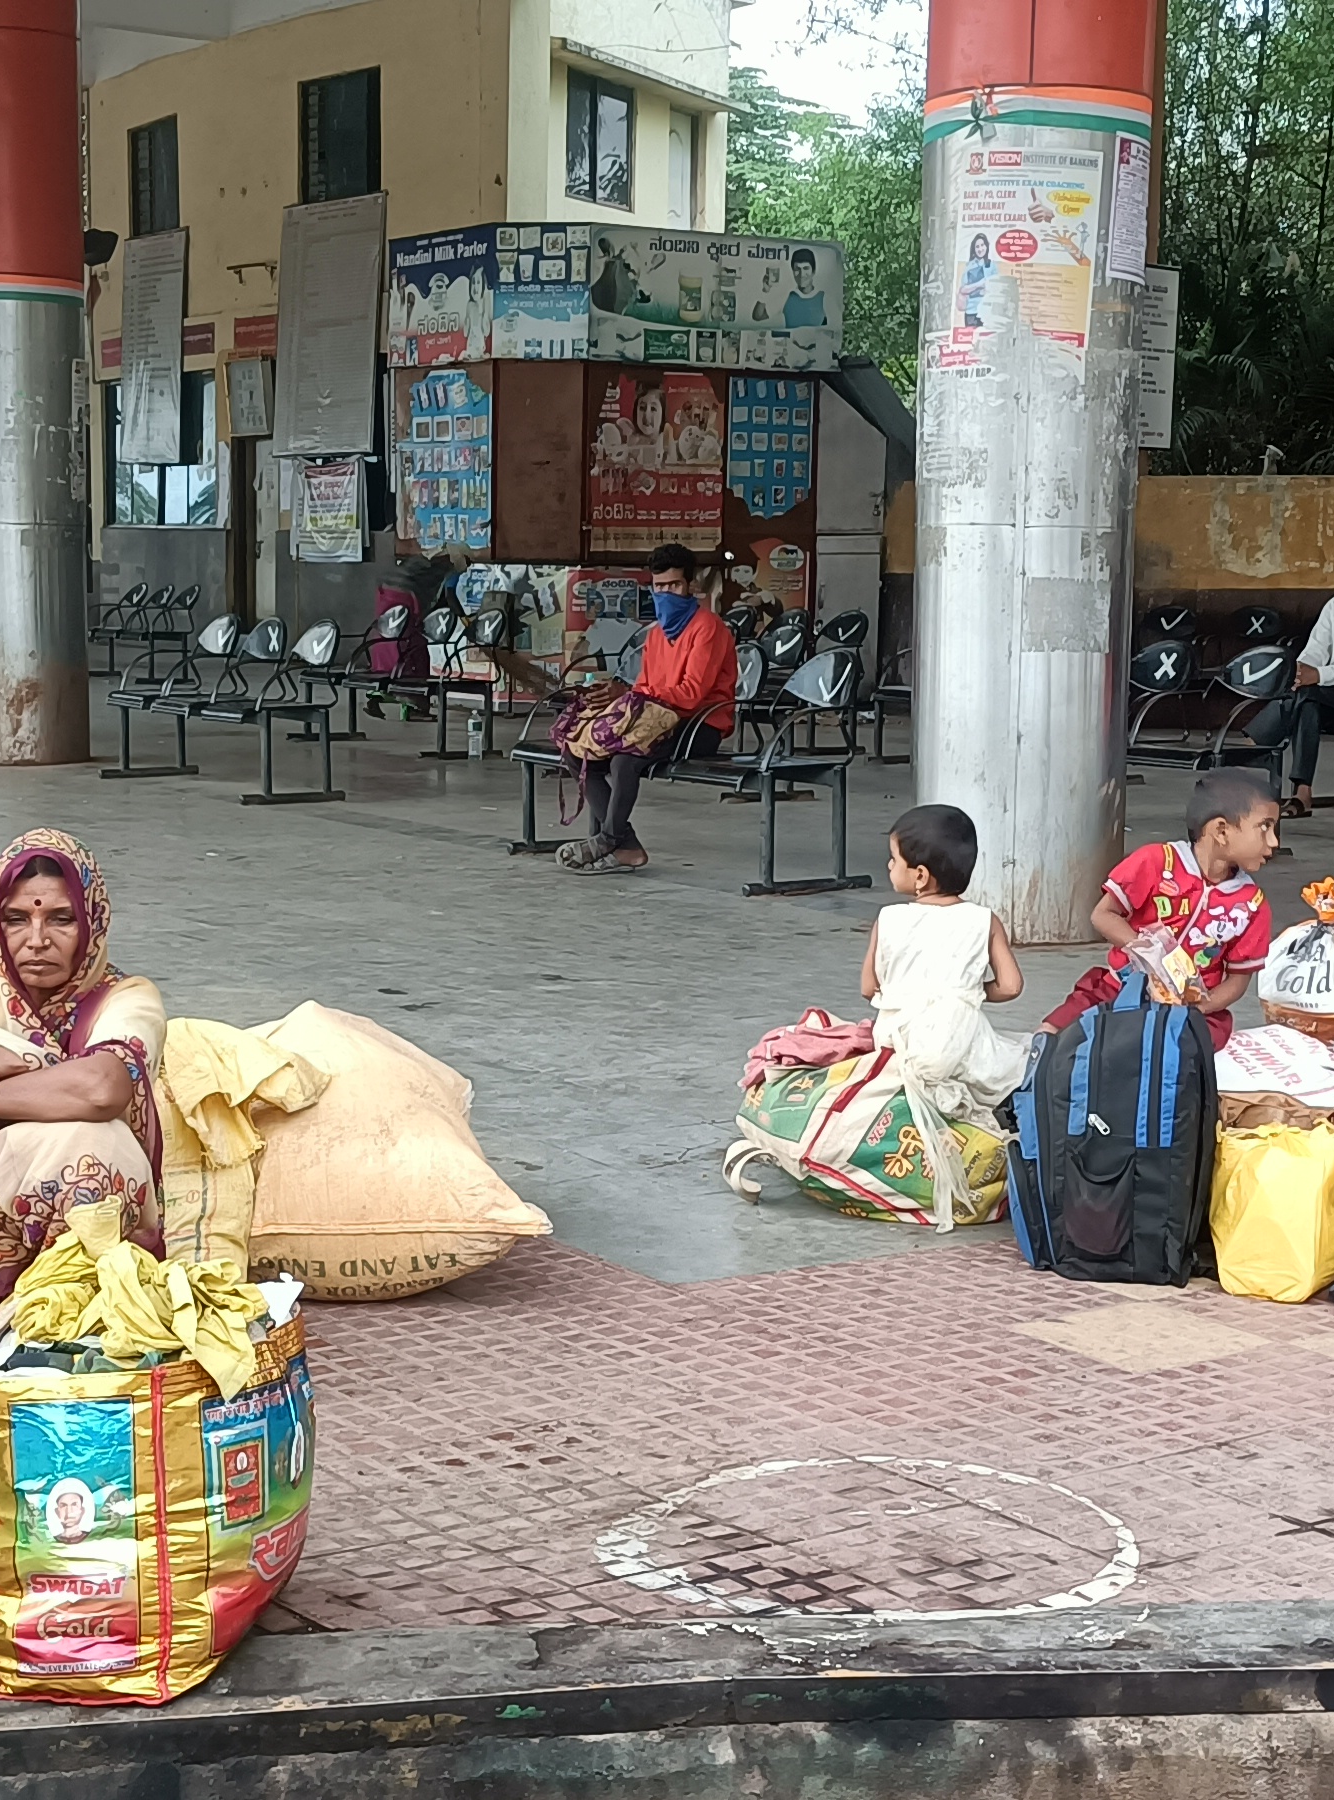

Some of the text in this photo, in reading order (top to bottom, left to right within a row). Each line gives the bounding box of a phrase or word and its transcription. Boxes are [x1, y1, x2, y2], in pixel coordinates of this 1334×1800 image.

[990, 154, 1098, 168] VISION INSTITUTE OF BANKING
[974, 179, 1020, 187] COMPETITIVE
[1046, 181, 1085, 189] COACHING
[396, 250, 432, 267] Nandini
[434, 245, 455, 262] Milk
[457, 241, 487, 259] Parlor
[1276, 959, 1332, 995] Gold
[1227, 1044, 1263, 1079] NGAL
[339, 1255, 398, 1278] AND
[408, 1252, 458, 1273] EAT
[30, 1574, 127, 1597] SWAGAT
[36, 1608, 115, 1643] Gold
[48, 1664, 73, 1673] EVERY
